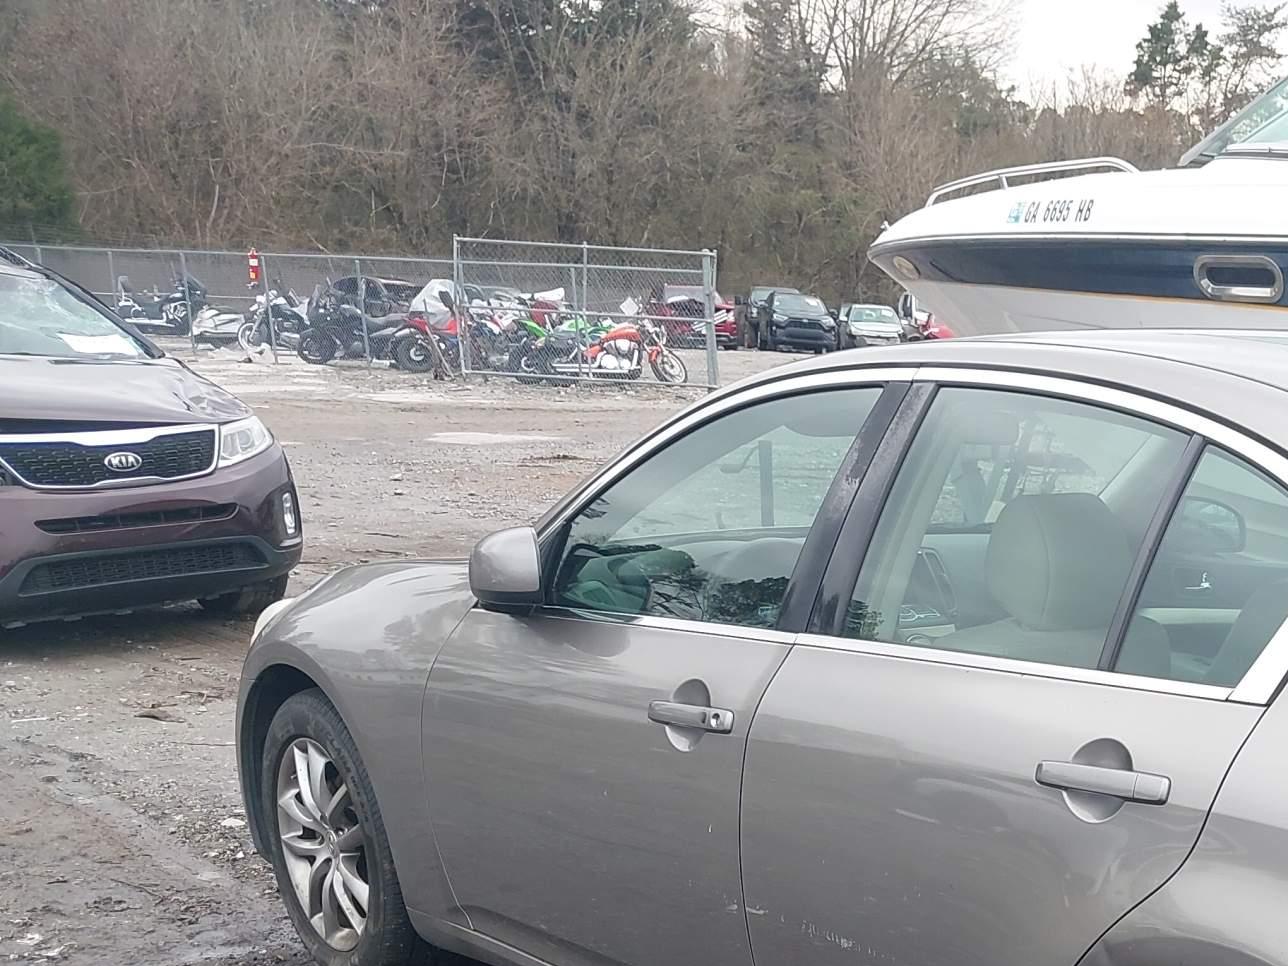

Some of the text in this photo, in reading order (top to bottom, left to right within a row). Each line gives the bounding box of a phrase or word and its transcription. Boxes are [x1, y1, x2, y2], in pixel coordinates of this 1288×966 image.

[1024, 200, 1041, 223] GA
[1042, 199, 1074, 223] 6695
[1074, 198, 1095, 223] HB
